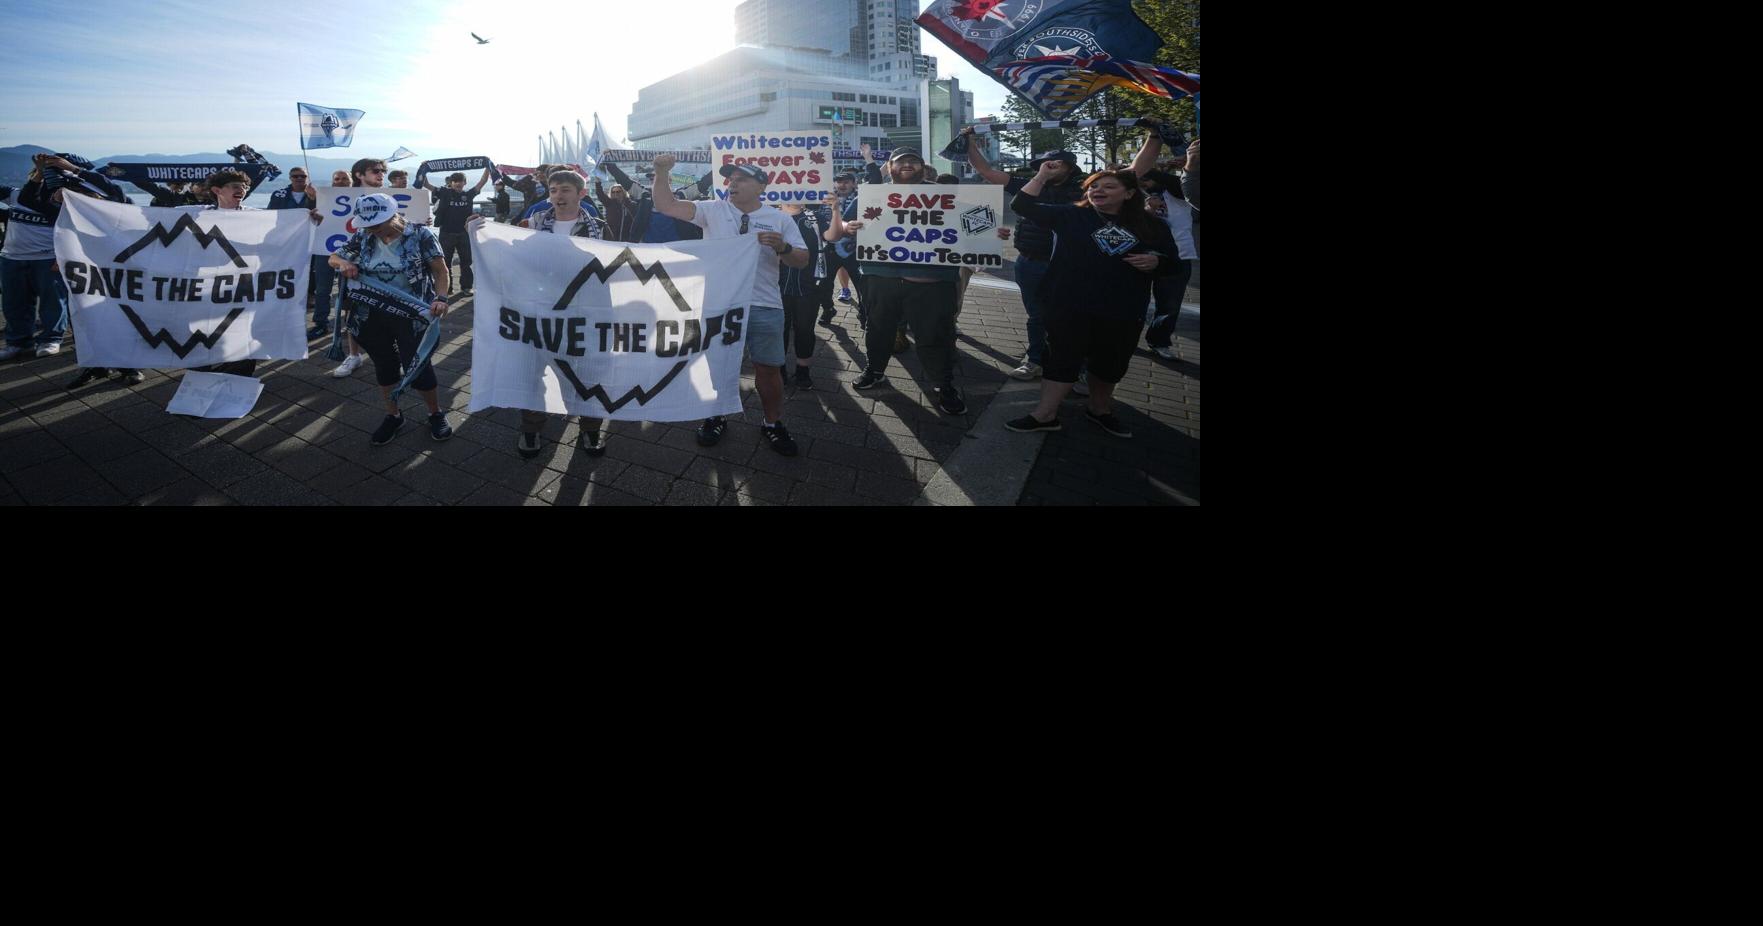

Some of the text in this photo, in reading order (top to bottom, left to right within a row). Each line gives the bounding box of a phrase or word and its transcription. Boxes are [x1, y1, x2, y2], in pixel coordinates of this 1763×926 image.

[1020, 3, 1038, 23] 1999
[713, 134, 830, 150] Whitecaps
[427, 159, 471, 170] WHITECAPS
[722, 154, 804, 167] Forever
[147, 167, 217, 179] WHITECAPS
[716, 189, 828, 202] Vcouver
[887, 193, 956, 210] SAVE
[332, 194, 412, 217] SE
[893, 209, 944, 226] THE
[885, 226, 958, 244] CAPS
[65, 261, 295, 303] SAVE THE CAPS
[499, 307, 745, 358] SAVE THE CAPS
